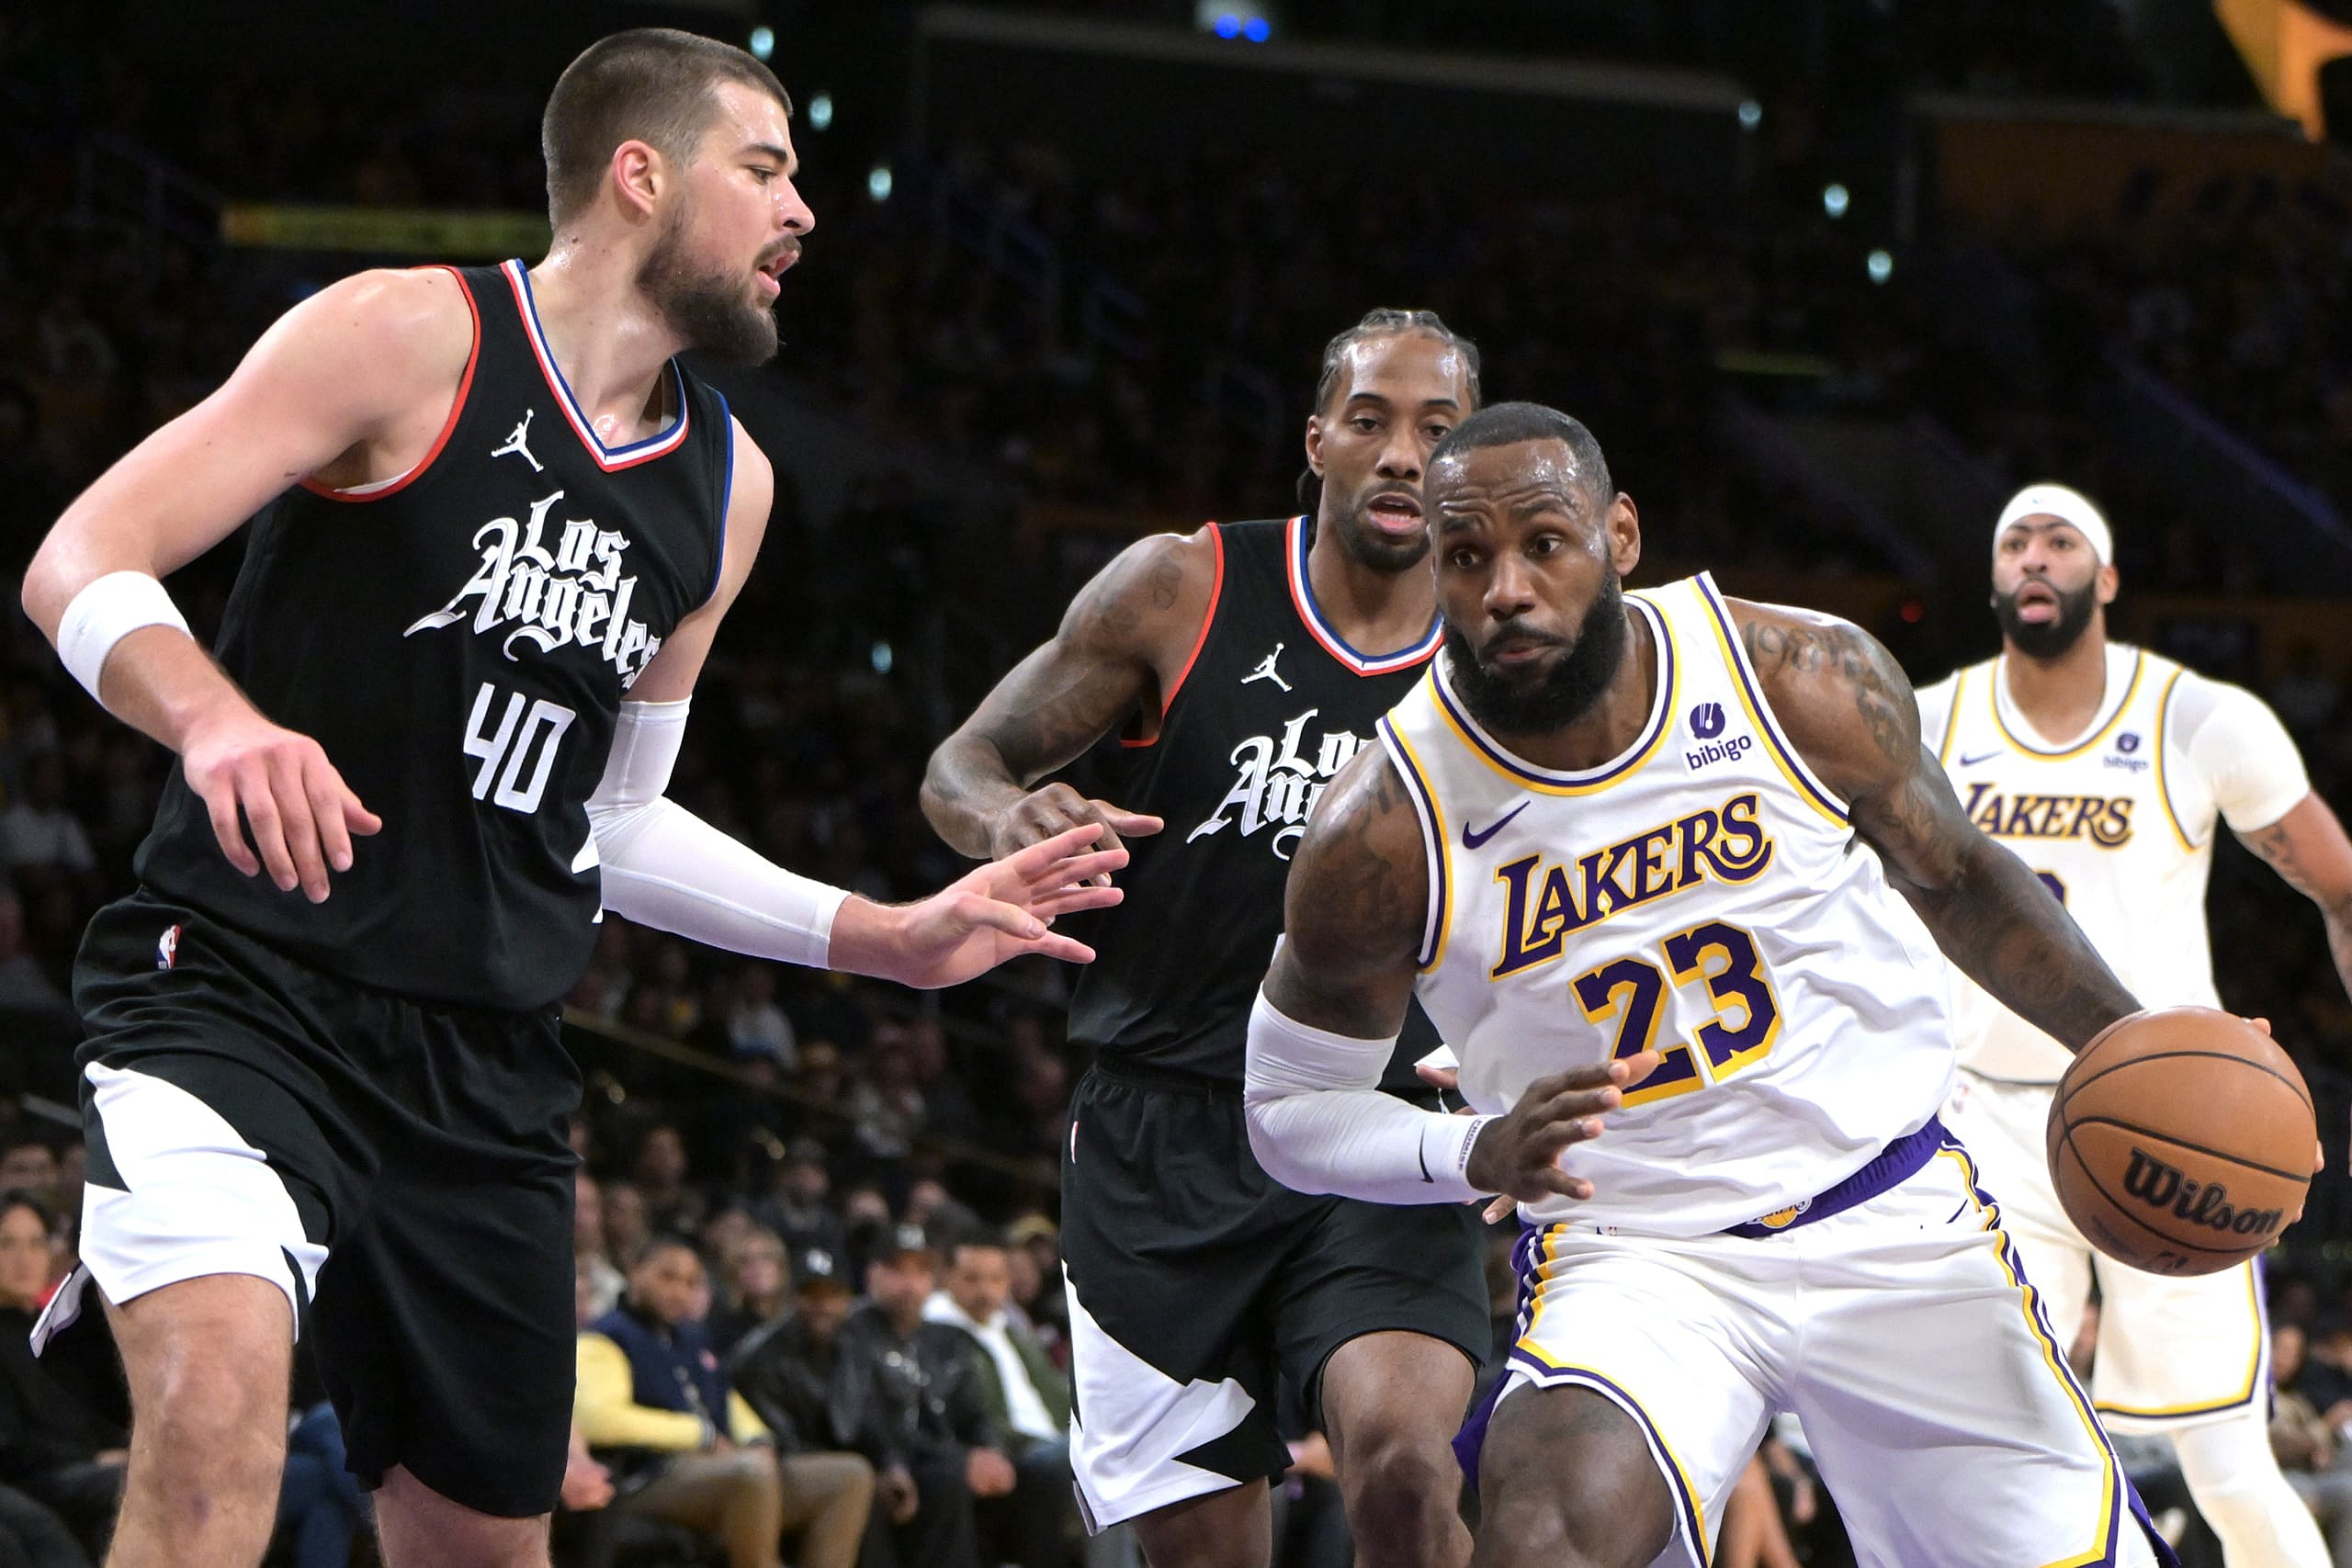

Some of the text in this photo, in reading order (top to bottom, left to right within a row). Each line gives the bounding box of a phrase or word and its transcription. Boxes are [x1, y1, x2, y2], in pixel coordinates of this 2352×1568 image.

[514, 491, 630, 592] Los
[462, 682, 577, 814] 40
[1270, 708, 1374, 779] Lo
[1686, 734, 1753, 771] bibigo
[1490, 793, 1774, 984] LAKERS
[1568, 919, 1784, 1109] 23
[2123, 1147, 2284, 1235] Wilson
